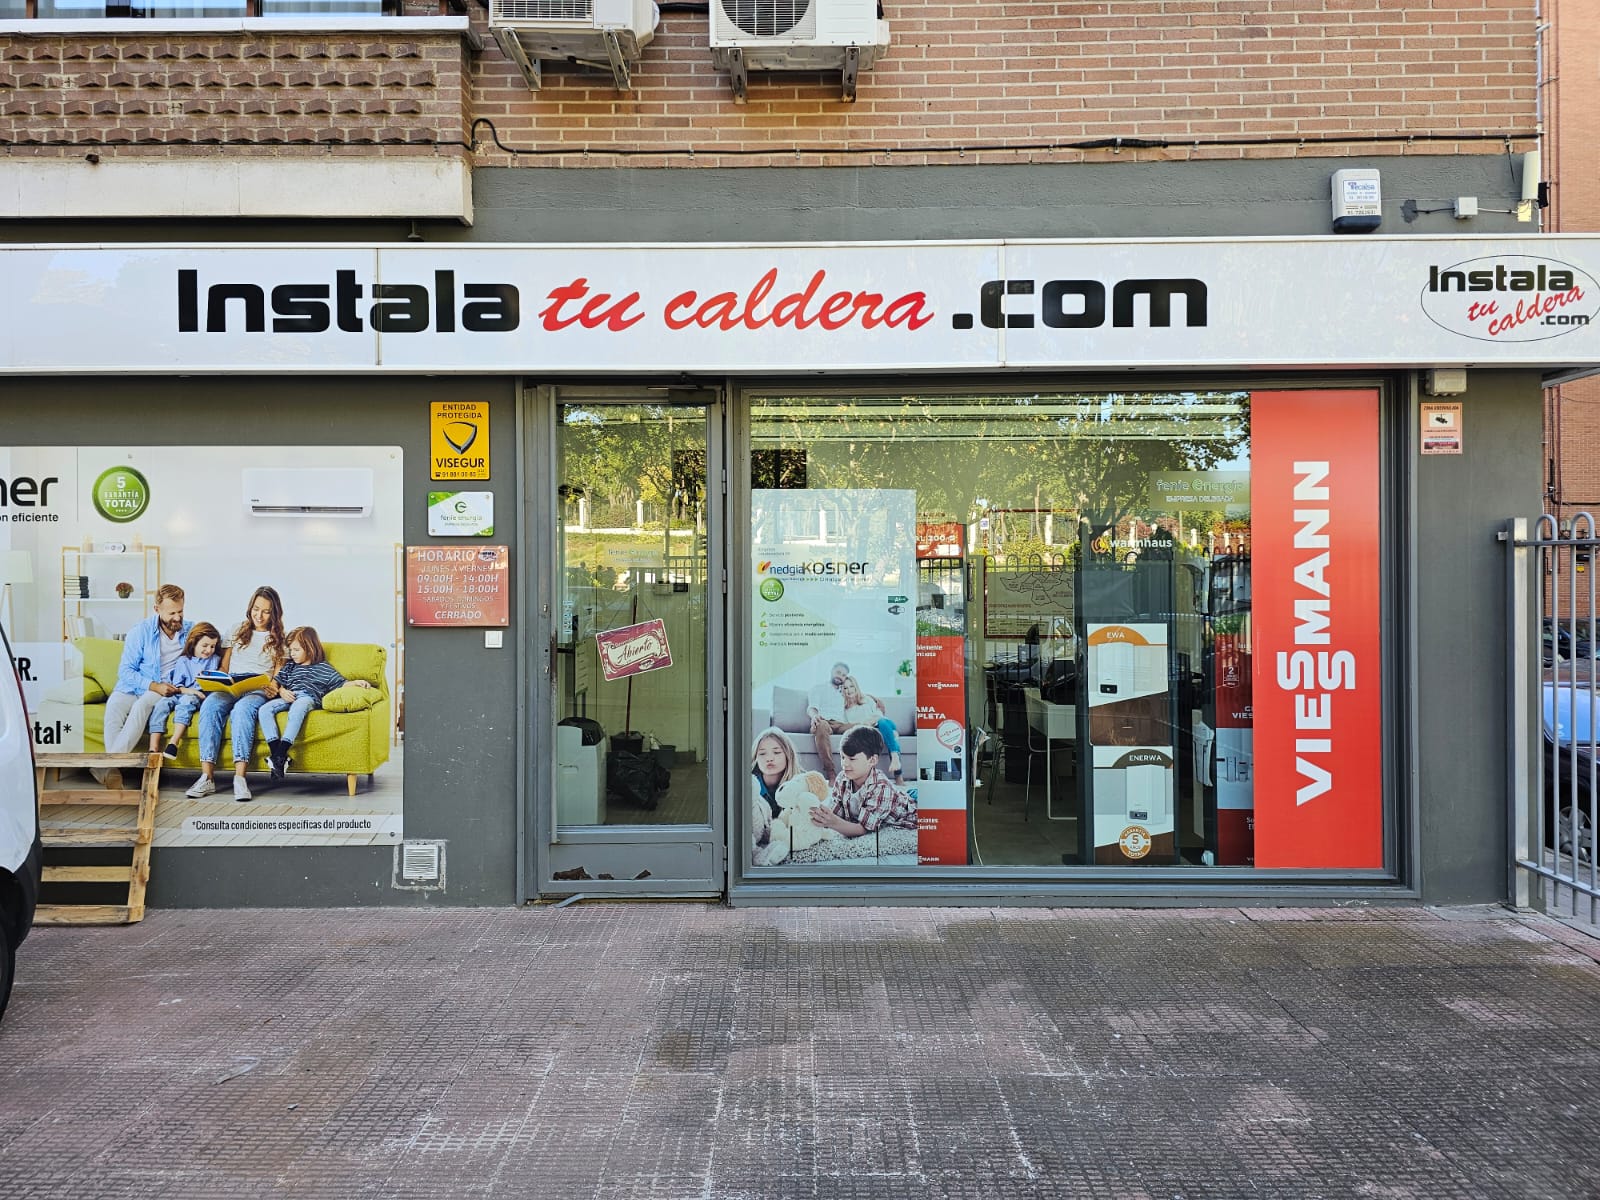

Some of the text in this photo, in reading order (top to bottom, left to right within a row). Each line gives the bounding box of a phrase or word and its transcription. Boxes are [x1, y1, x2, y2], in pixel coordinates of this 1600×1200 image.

[1429, 264, 1574, 292] Instala
[179, 267, 1208, 333] Instala tu caldera .com
[1467, 300, 1499, 321] tu
[1488, 285, 1585, 336] caldera
[1540, 314, 1590, 326] .com
[442, 403, 477, 411] ENTIDAD
[436, 458, 485, 468] VISEGUR
[117, 476, 126, 489] 5
[105, 499, 138, 508] TOTAL
[12, 512, 58, 522] eficiente
[417, 550, 475, 562] HORARIO
[769, 564, 804, 576] nedgia
[417, 574, 453, 583] 09:00H
[463, 574, 498, 583] 14:00H
[417, 585, 453, 594] 15:00H
[463, 585, 498, 593] 18:00H
[434, 611, 482, 619] CERRADO
[1276, 460, 1356, 807] VIESSMANN
[617, 638, 652, 663] Abierto
[231, 819, 277, 830] condiciones
[323, 818, 335, 829] del
[336, 818, 371, 831] producto
[1132, 835, 1139, 844] 5
